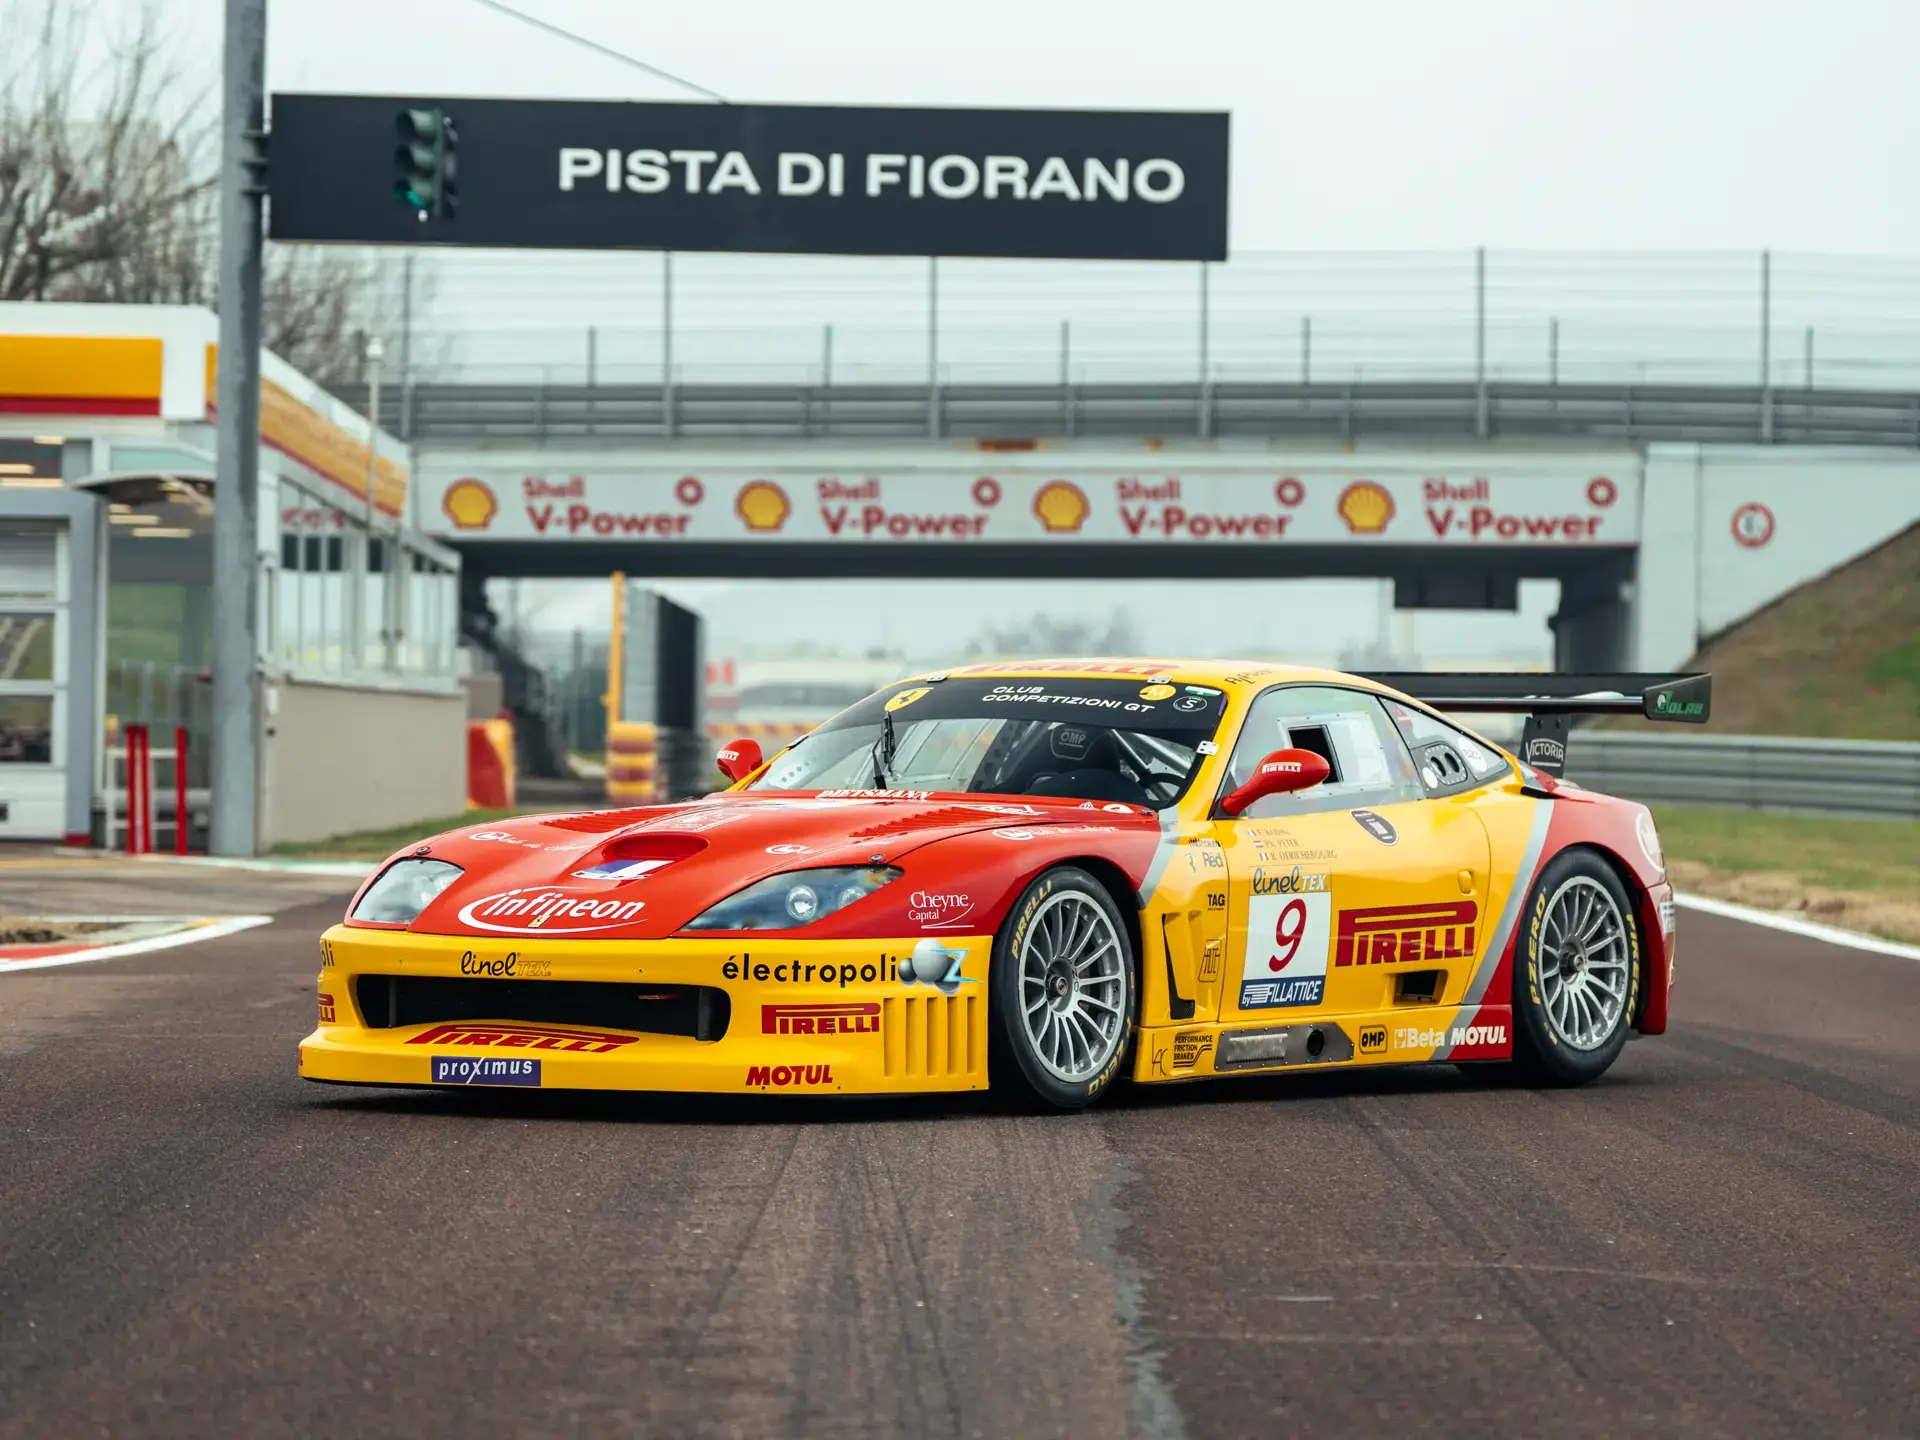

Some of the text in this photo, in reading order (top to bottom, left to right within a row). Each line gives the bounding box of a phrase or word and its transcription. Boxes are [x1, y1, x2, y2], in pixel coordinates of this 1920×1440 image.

[558, 147, 1186, 203] PISTA DI FIORANO
[523, 476, 585, 499] Shell
[816, 477, 880, 501] Shell
[1116, 477, 1181, 501] Shell
[1422, 477, 1489, 502] Shell
[525, 504, 693, 536] V-Power
[820, 505, 991, 538] V-Power
[1119, 505, 1293, 538] V-Power
[1425, 507, 1604, 538] V-Power
[992, 686, 1044, 694] CLUB
[982, 694, 1155, 713] COMPETIZIONI GT
[1525, 738, 1564, 766] VICTORIA
[1262, 761, 1302, 774] PIRELLI
[1253, 866, 1327, 894] linel TEX
[481, 889, 646, 920] infineon
[910, 891, 969, 912] Cheyne
[1208, 894, 1226, 907] TAG
[908, 909, 940, 923] Capital
[1012, 880, 1053, 959] PIRELLI
[1269, 898, 1307, 972] 9
[1336, 901, 1478, 967] PIRELLI
[461, 950, 551, 977] linel TEX
[722, 953, 897, 988] électropoli
[1242, 981, 1322, 1006] by FILLATTICE
[761, 1002, 881, 1034] PIRELLI
[404, 1024, 640, 1053] PIRELLI
[1174, 1044, 1198, 1053] FRICTION
[1175, 1035, 1213, 1043] PERFORMANCE
[1362, 1031, 1385, 1047] OMP
[1407, 1026, 1507, 1047] Beta MOTUL
[439, 1057, 533, 1084] proximus
[745, 1065, 833, 1086] MOTUL
